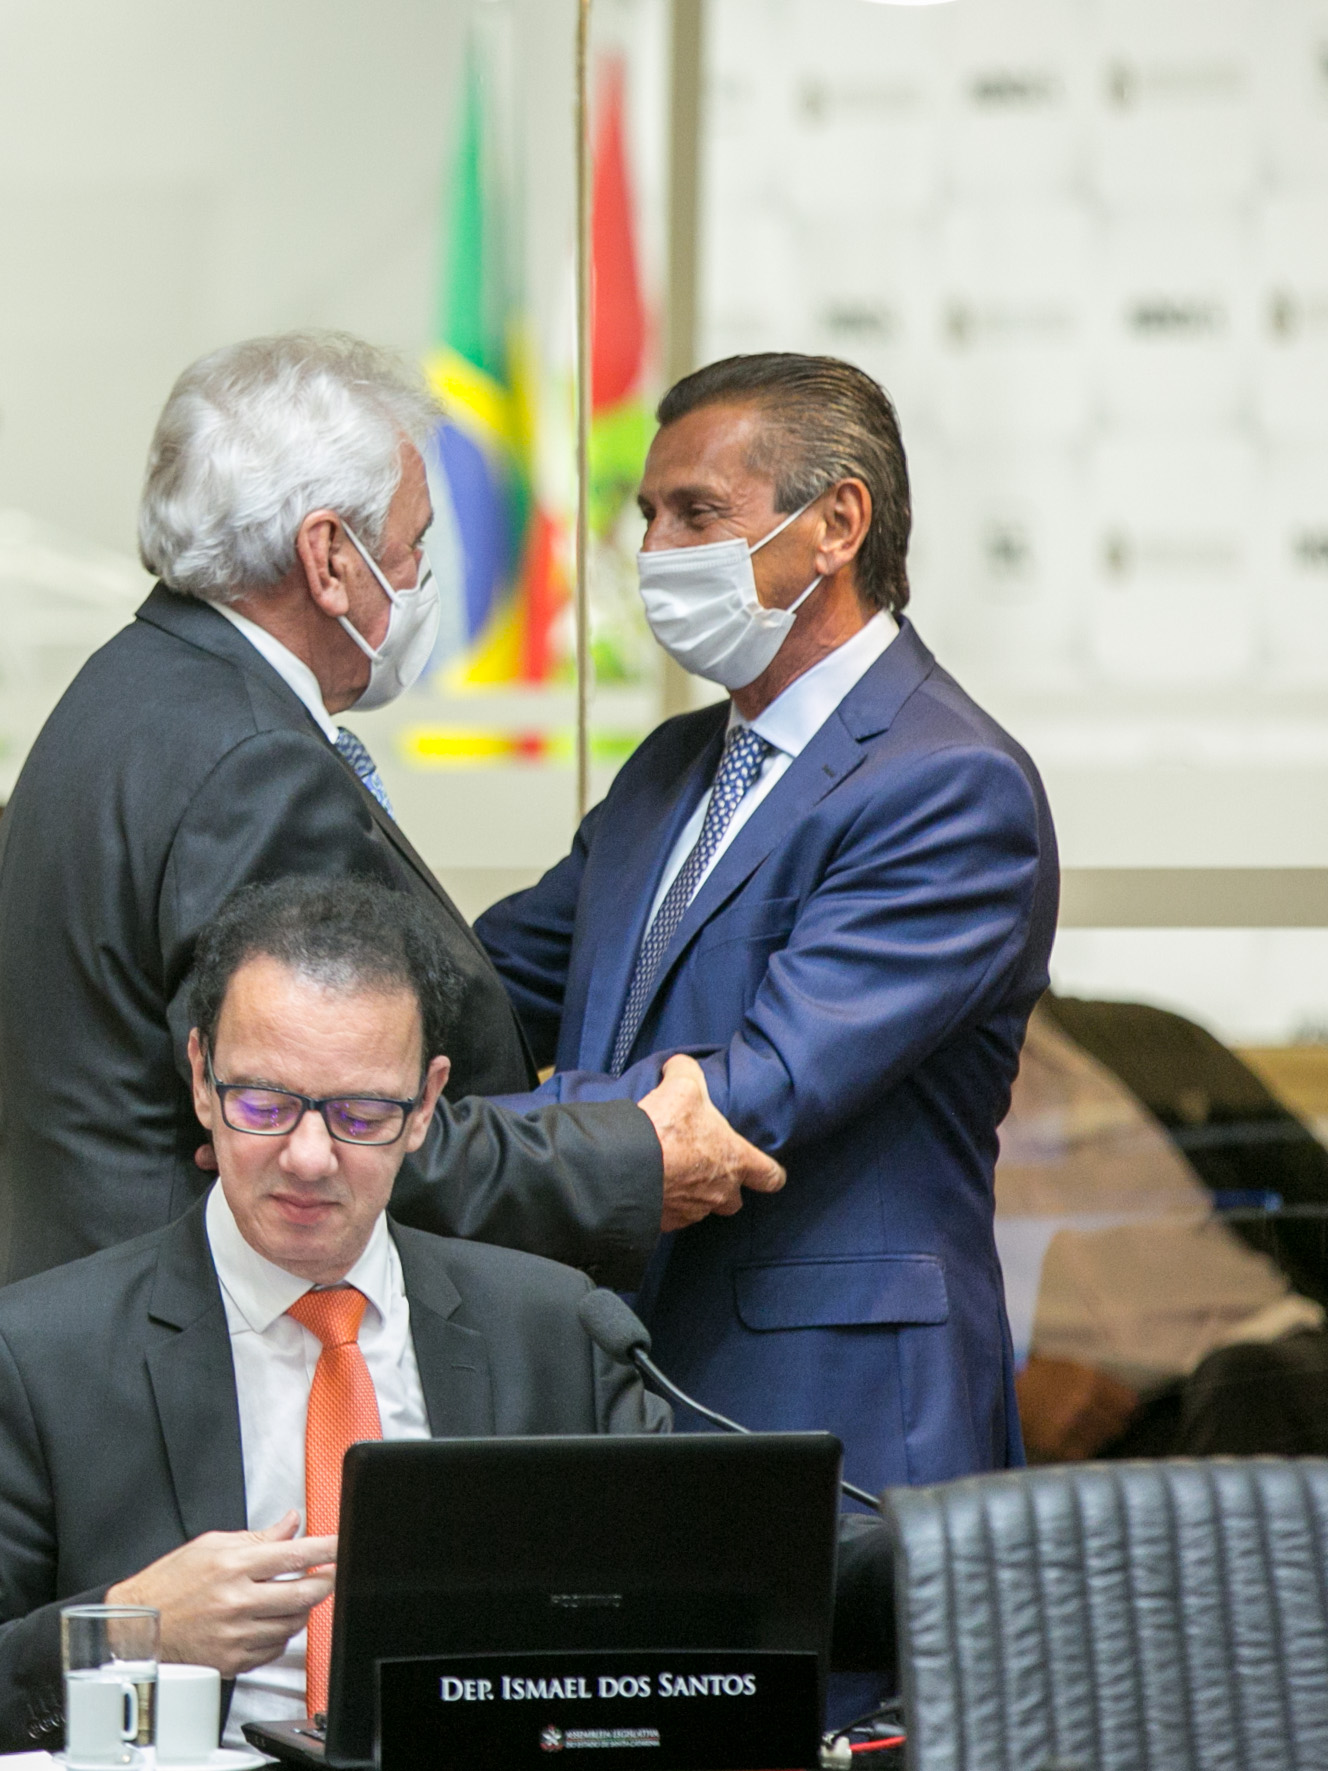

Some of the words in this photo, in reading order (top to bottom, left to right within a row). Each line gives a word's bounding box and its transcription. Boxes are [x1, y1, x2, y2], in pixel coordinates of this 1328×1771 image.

[440, 1676, 494, 1701] DEP.
[501, 1675, 592, 1700] ISMAEL
[598, 1676, 651, 1698] DOS
[658, 1671, 756, 1697] SANTOS
